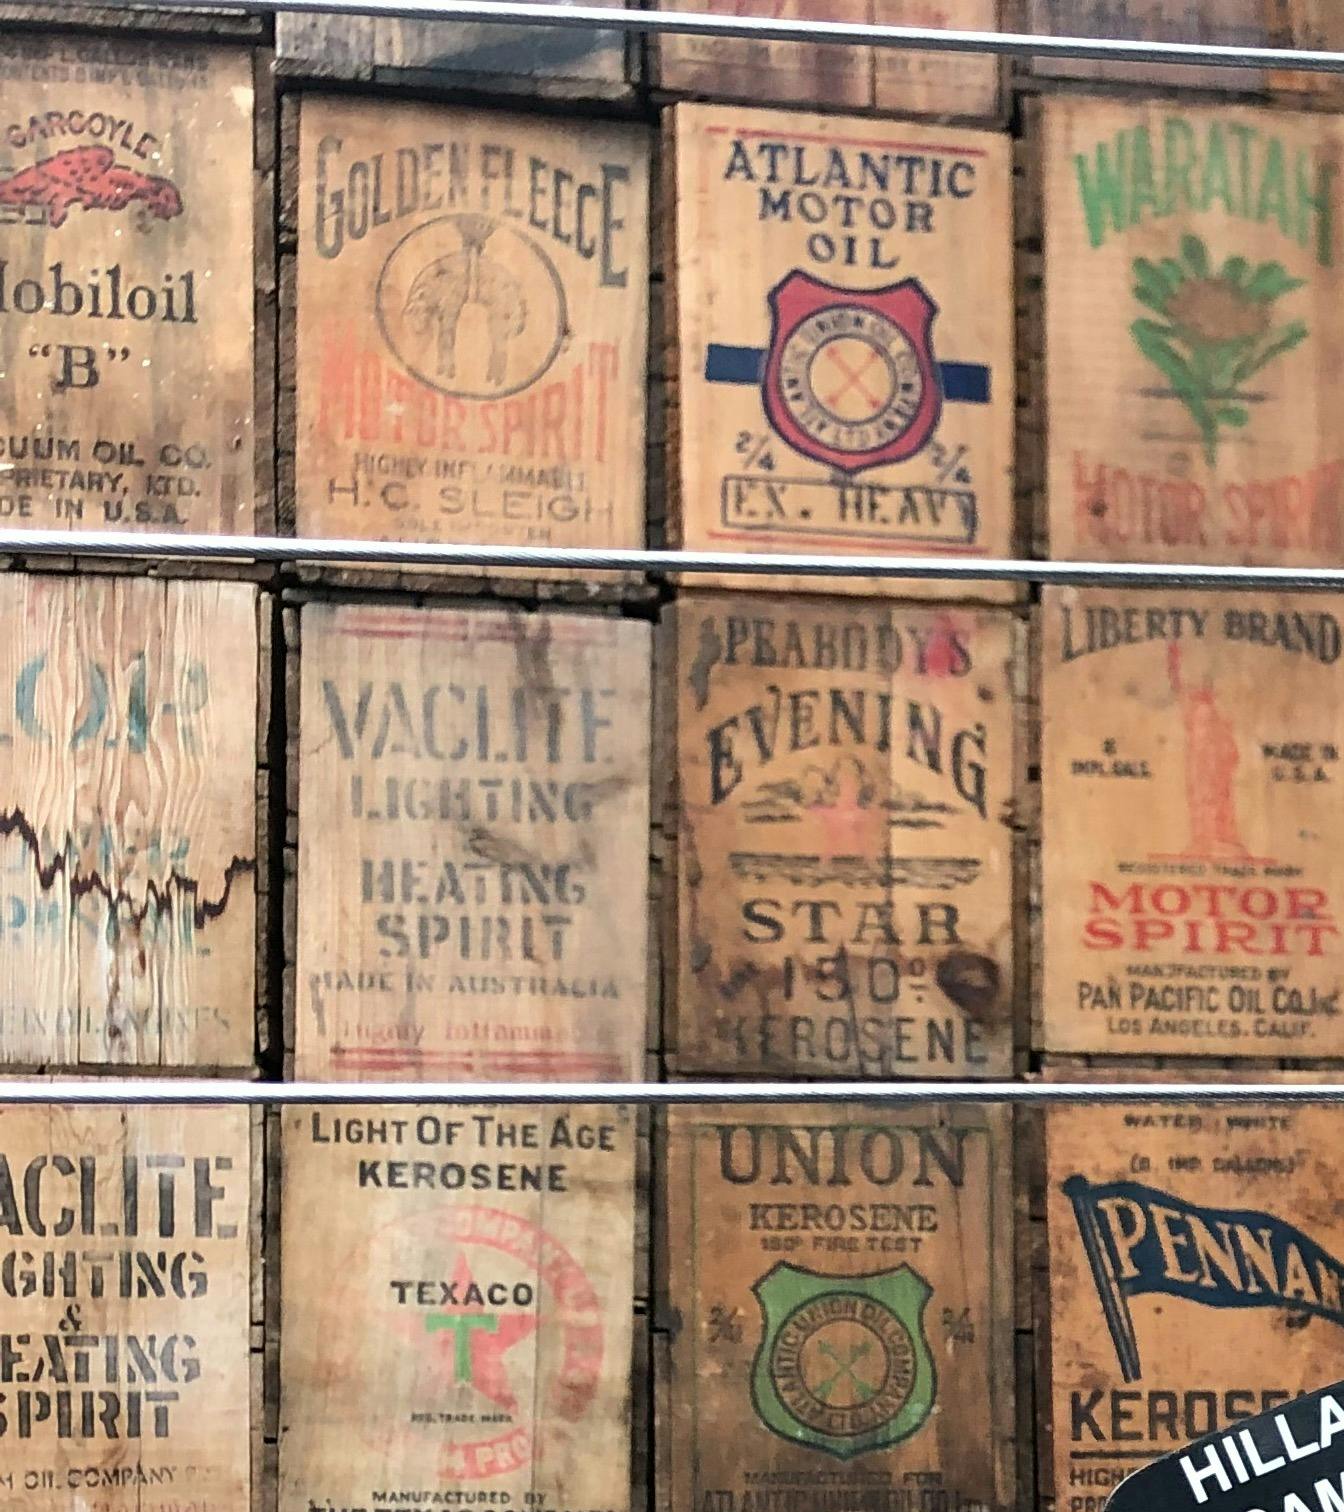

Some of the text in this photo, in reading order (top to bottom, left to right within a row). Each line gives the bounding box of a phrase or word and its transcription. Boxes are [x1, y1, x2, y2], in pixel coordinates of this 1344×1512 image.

[723, 139, 977, 201] ATLANTIC
[1073, 116, 1338, 269] WARATAH
[314, 134, 631, 290] GOLDEN FLEECE
[757, 190, 937, 235] MOTOR
[807, 233, 901, 271] OIL
[480, 340, 619, 465] SPIRIT
[92, 441, 143, 468] OIL
[55, 499, 83, 524] IN
[437, 485, 616, 529] SLEIGH
[722, 611, 973, 679] PEABODY'S
[1059, 605, 1344, 667] LIBERTY BRAND
[321, 679, 618, 766] VACLITE
[705, 683, 989, 821] EVENING
[350, 776, 596, 824] LIGHTING
[360, 856, 589, 907] HEATING
[1088, 880, 1335, 920] MOTOR
[376, 912, 574, 961] SPIRIT
[741, 897, 963, 946] STAR
[1081, 916, 1342, 957] SPIRIT
[1128, 980, 1266, 1015] PACIFIC OIL
[716, 1012, 988, 1066] KEROSENE
[1106, 1014, 1143, 1037] LOS
[311, 1114, 618, 1152] LIGHT OF THE AGE
[357, 1159, 570, 1193] KEROSENE
[715, 1126, 971, 1189] UNION
[749, 1202, 939, 1233] KEROSENE
[2, 1251, 209, 1299] GHTING
[389, 1280, 534, 1307] TEXACO
[57, 1303, 84, 1333] &
[0, 1333, 202, 1384] EATING
[66, 1465, 177, 1490] COMPANY
[371, 1489, 548, 1507] MANUFACTURED BY
